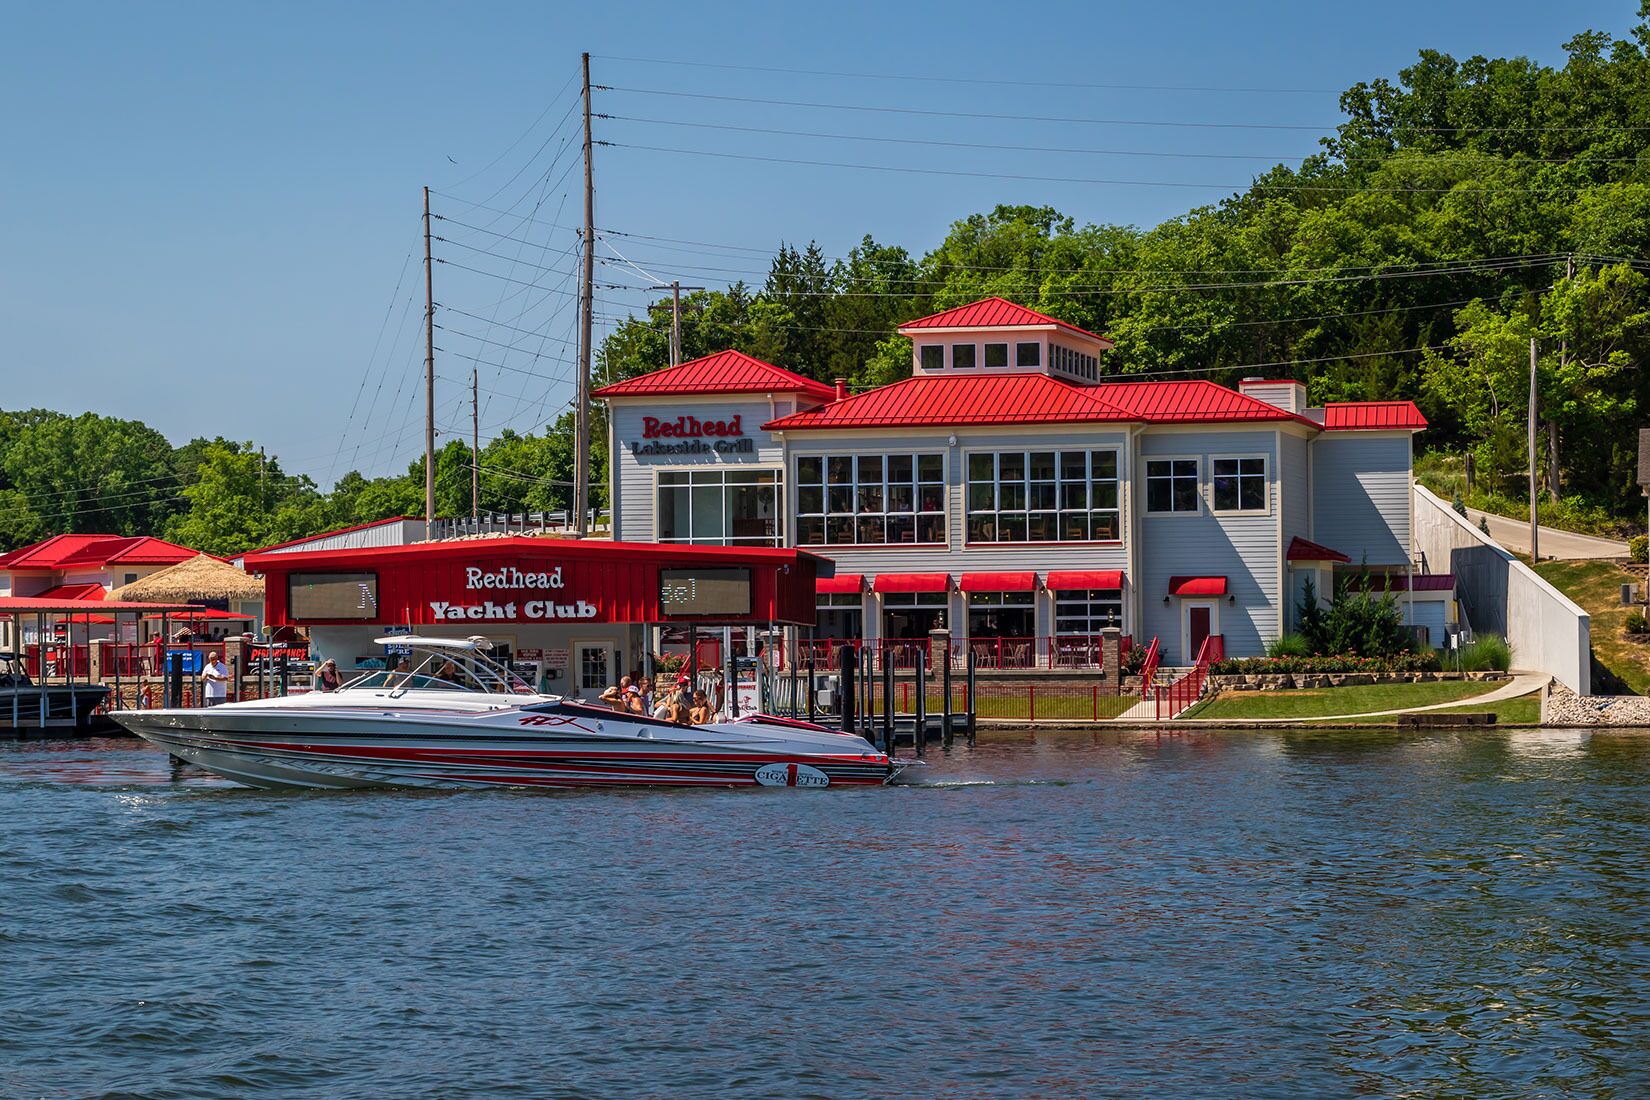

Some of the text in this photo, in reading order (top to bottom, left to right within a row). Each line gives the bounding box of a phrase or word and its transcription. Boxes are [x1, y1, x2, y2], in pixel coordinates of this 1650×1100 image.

[642, 415, 743, 438] Redhead
[631, 438, 753, 455] Lakeside Grill
[465, 567, 565, 589] Redhead
[430, 600, 597, 619] Yacht Club
[756, 770, 828, 786] CIGAETTE
